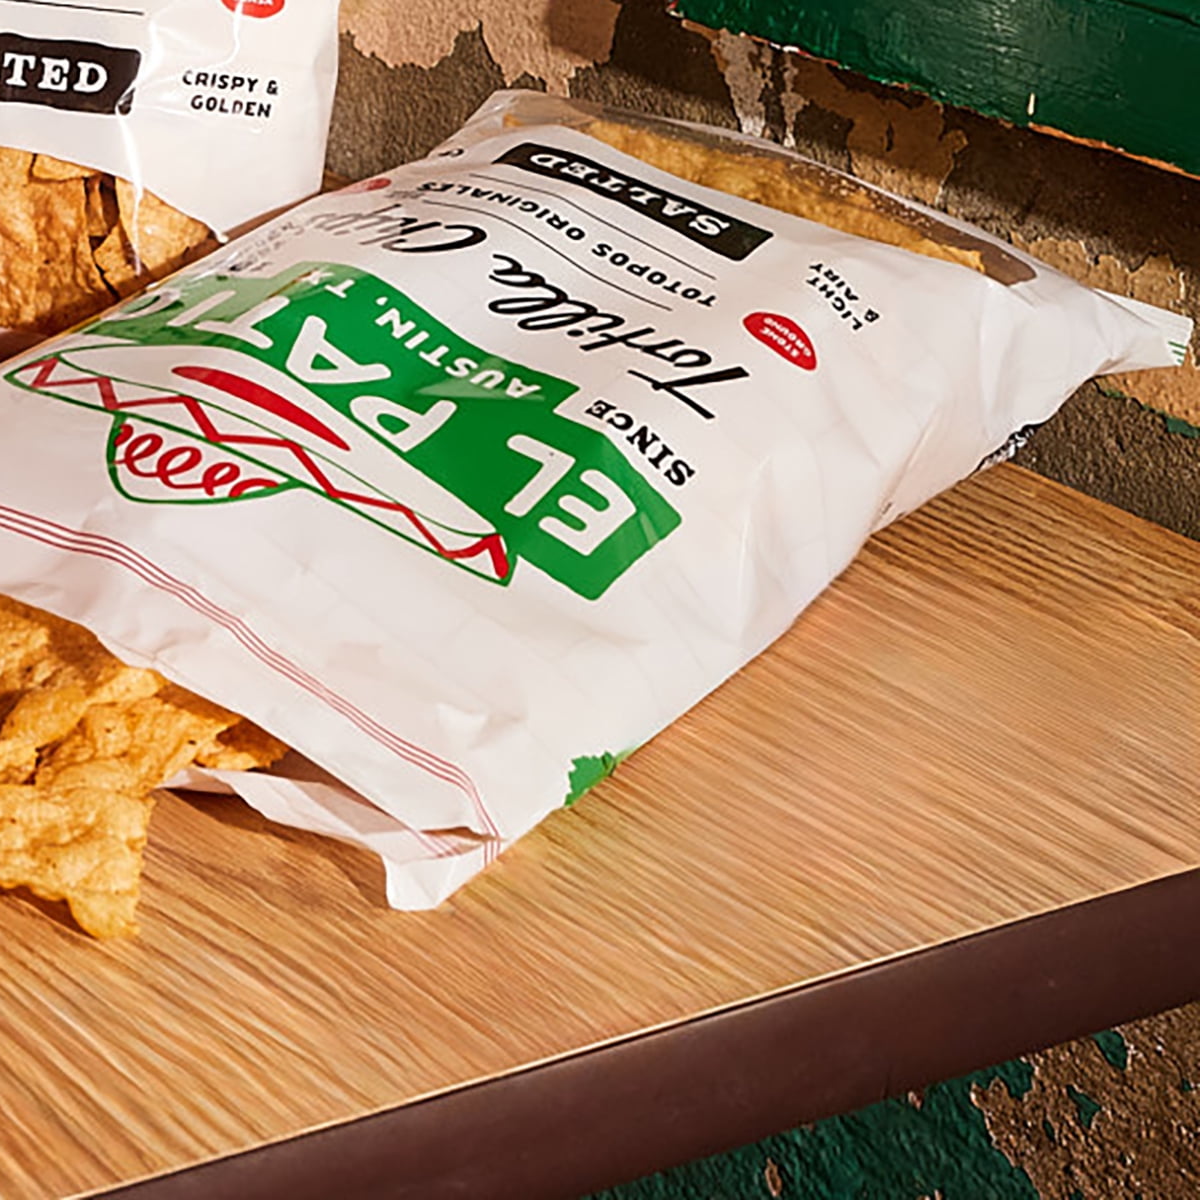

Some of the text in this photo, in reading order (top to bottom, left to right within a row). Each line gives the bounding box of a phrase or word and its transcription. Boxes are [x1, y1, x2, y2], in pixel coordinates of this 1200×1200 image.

[182, 70, 279, 96] CRISPY &
[190, 95, 272, 119] GOLDEN
[529, 154, 731, 237] SALTED
[417, 182, 716, 307] TOTOPOS ORIGINALES
[806, 277, 863, 331] LIGHT
[809, 263, 859, 302] AIRY
[375, 296, 542, 398] AUSTIN,
[488, 254, 750, 420] Tortilla
[759, 327, 799, 358] STONE
[763, 317, 812, 357] GROUND
[584, 400, 695, 486] SINCE
[503, 434, 637, 557] EL
